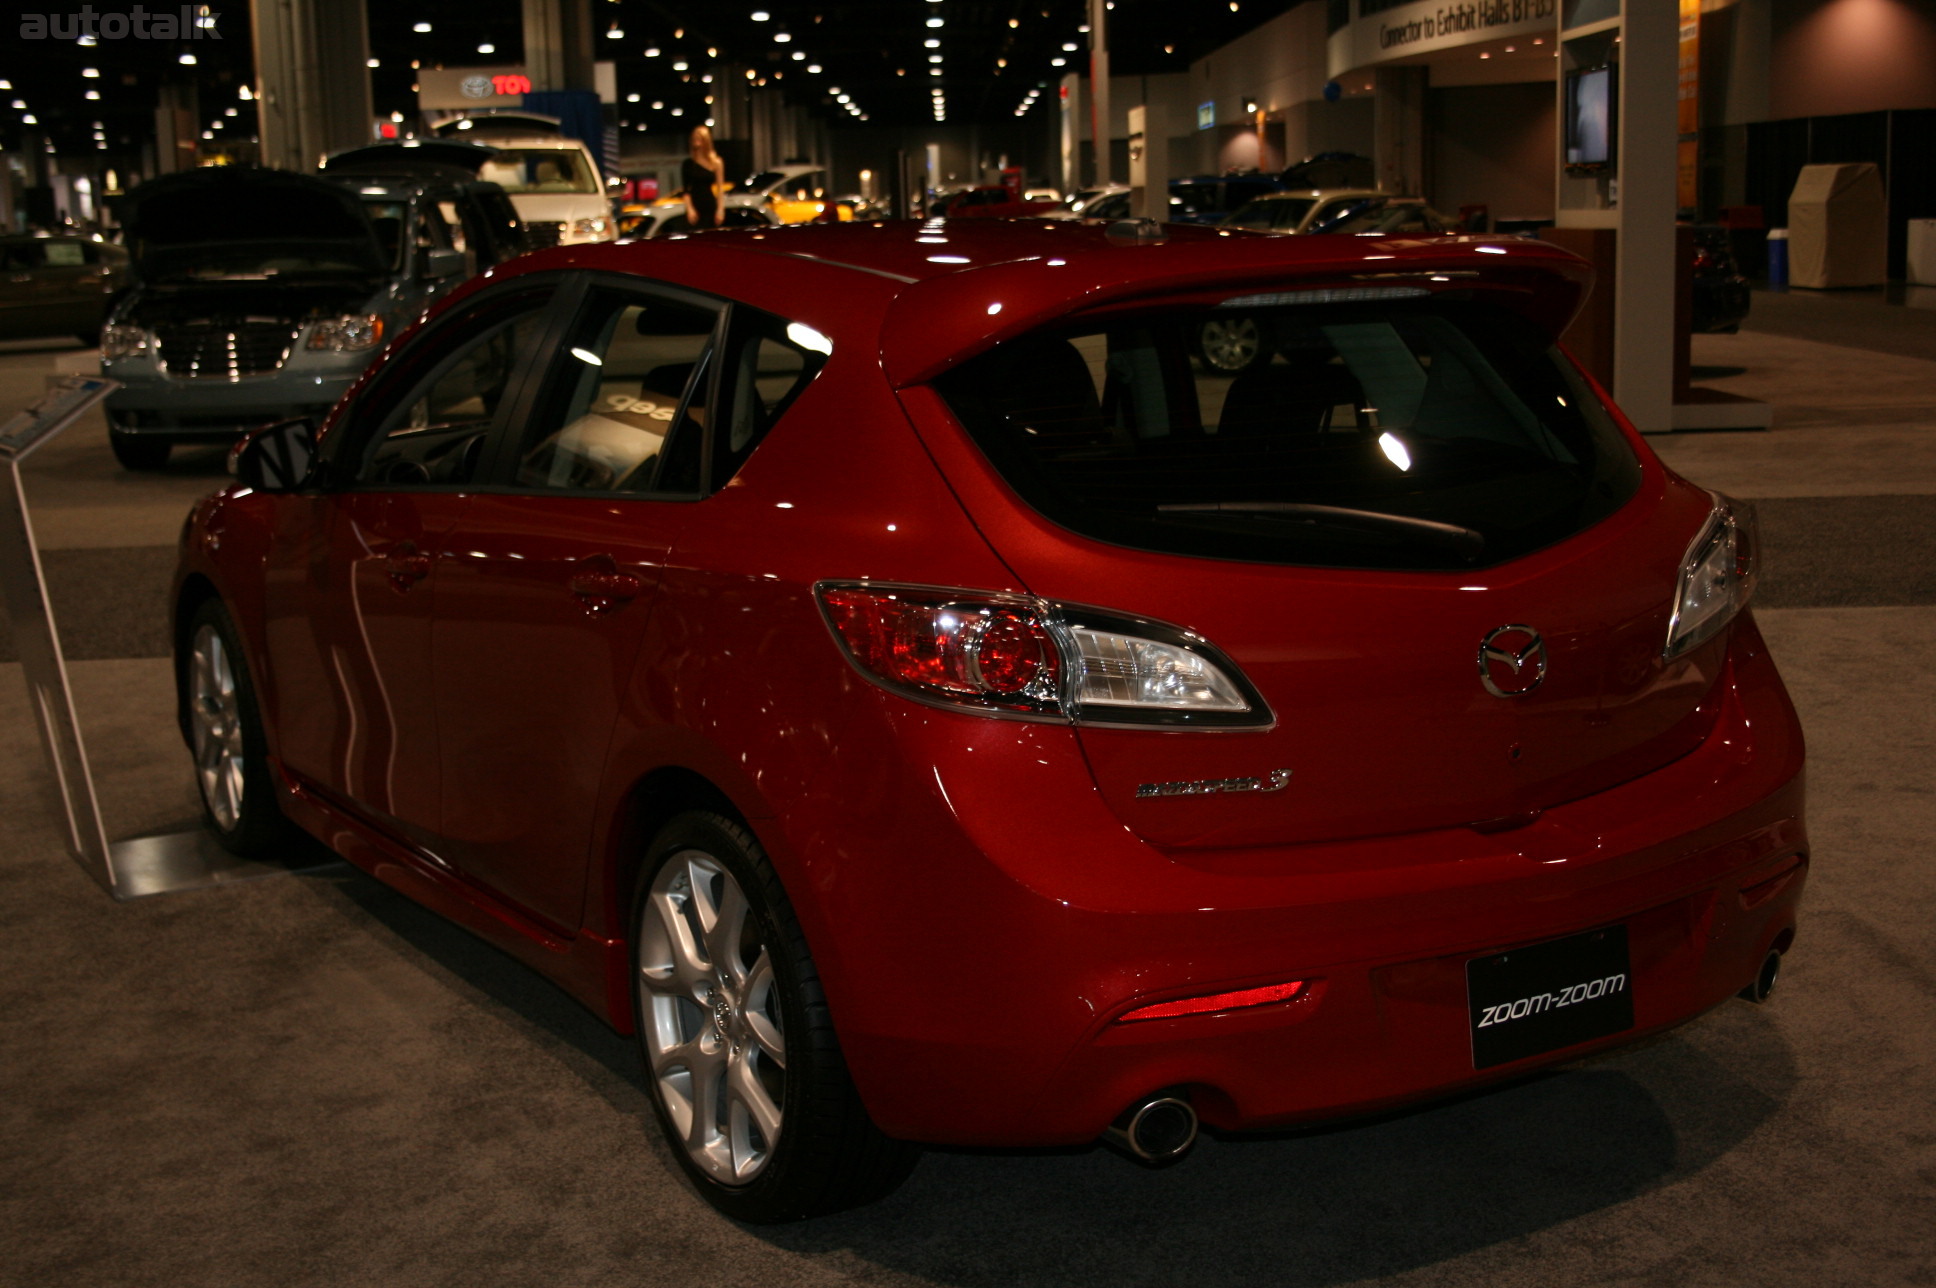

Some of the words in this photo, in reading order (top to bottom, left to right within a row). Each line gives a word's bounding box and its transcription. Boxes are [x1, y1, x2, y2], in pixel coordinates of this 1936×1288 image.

[1379, 24, 1421, 49] Connector
[1424, 16, 1435, 38] to
[1437, 4, 1475, 36] Exhibit
[1478, 0, 1509, 28] Halls
